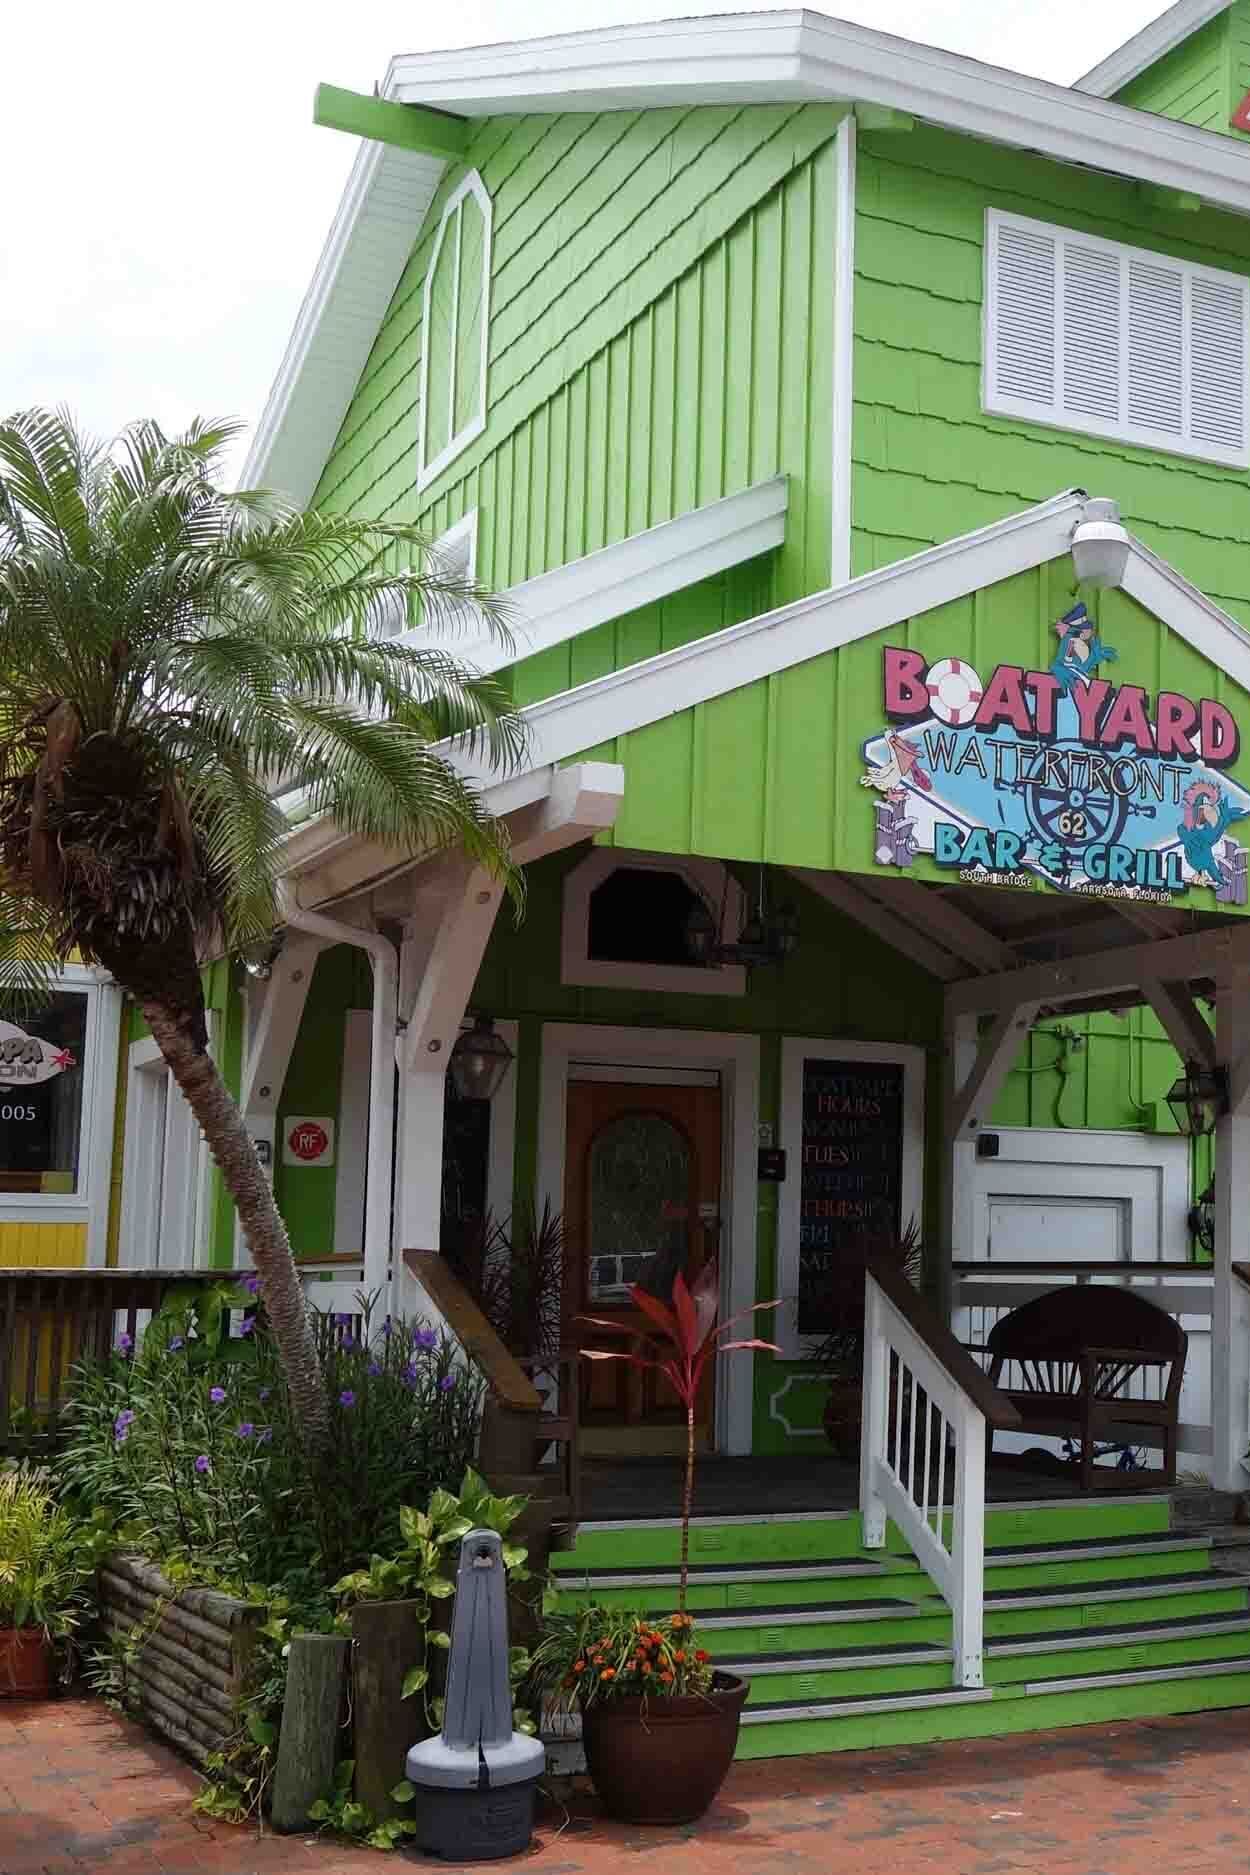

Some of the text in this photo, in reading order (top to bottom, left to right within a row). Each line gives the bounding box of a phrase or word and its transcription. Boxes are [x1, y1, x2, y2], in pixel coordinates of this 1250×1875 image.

[882, 646, 1240, 766] BOATYARD
[924, 730, 1192, 804] WATERFRONT
[1057, 809, 1087, 838] 62
[934, 822, 1023, 872] BAR
[1082, 843, 1185, 890] GRILL
[959, 870, 1032, 888] SOUTH BRIDGE
[299, 1133, 319, 1152] RF
